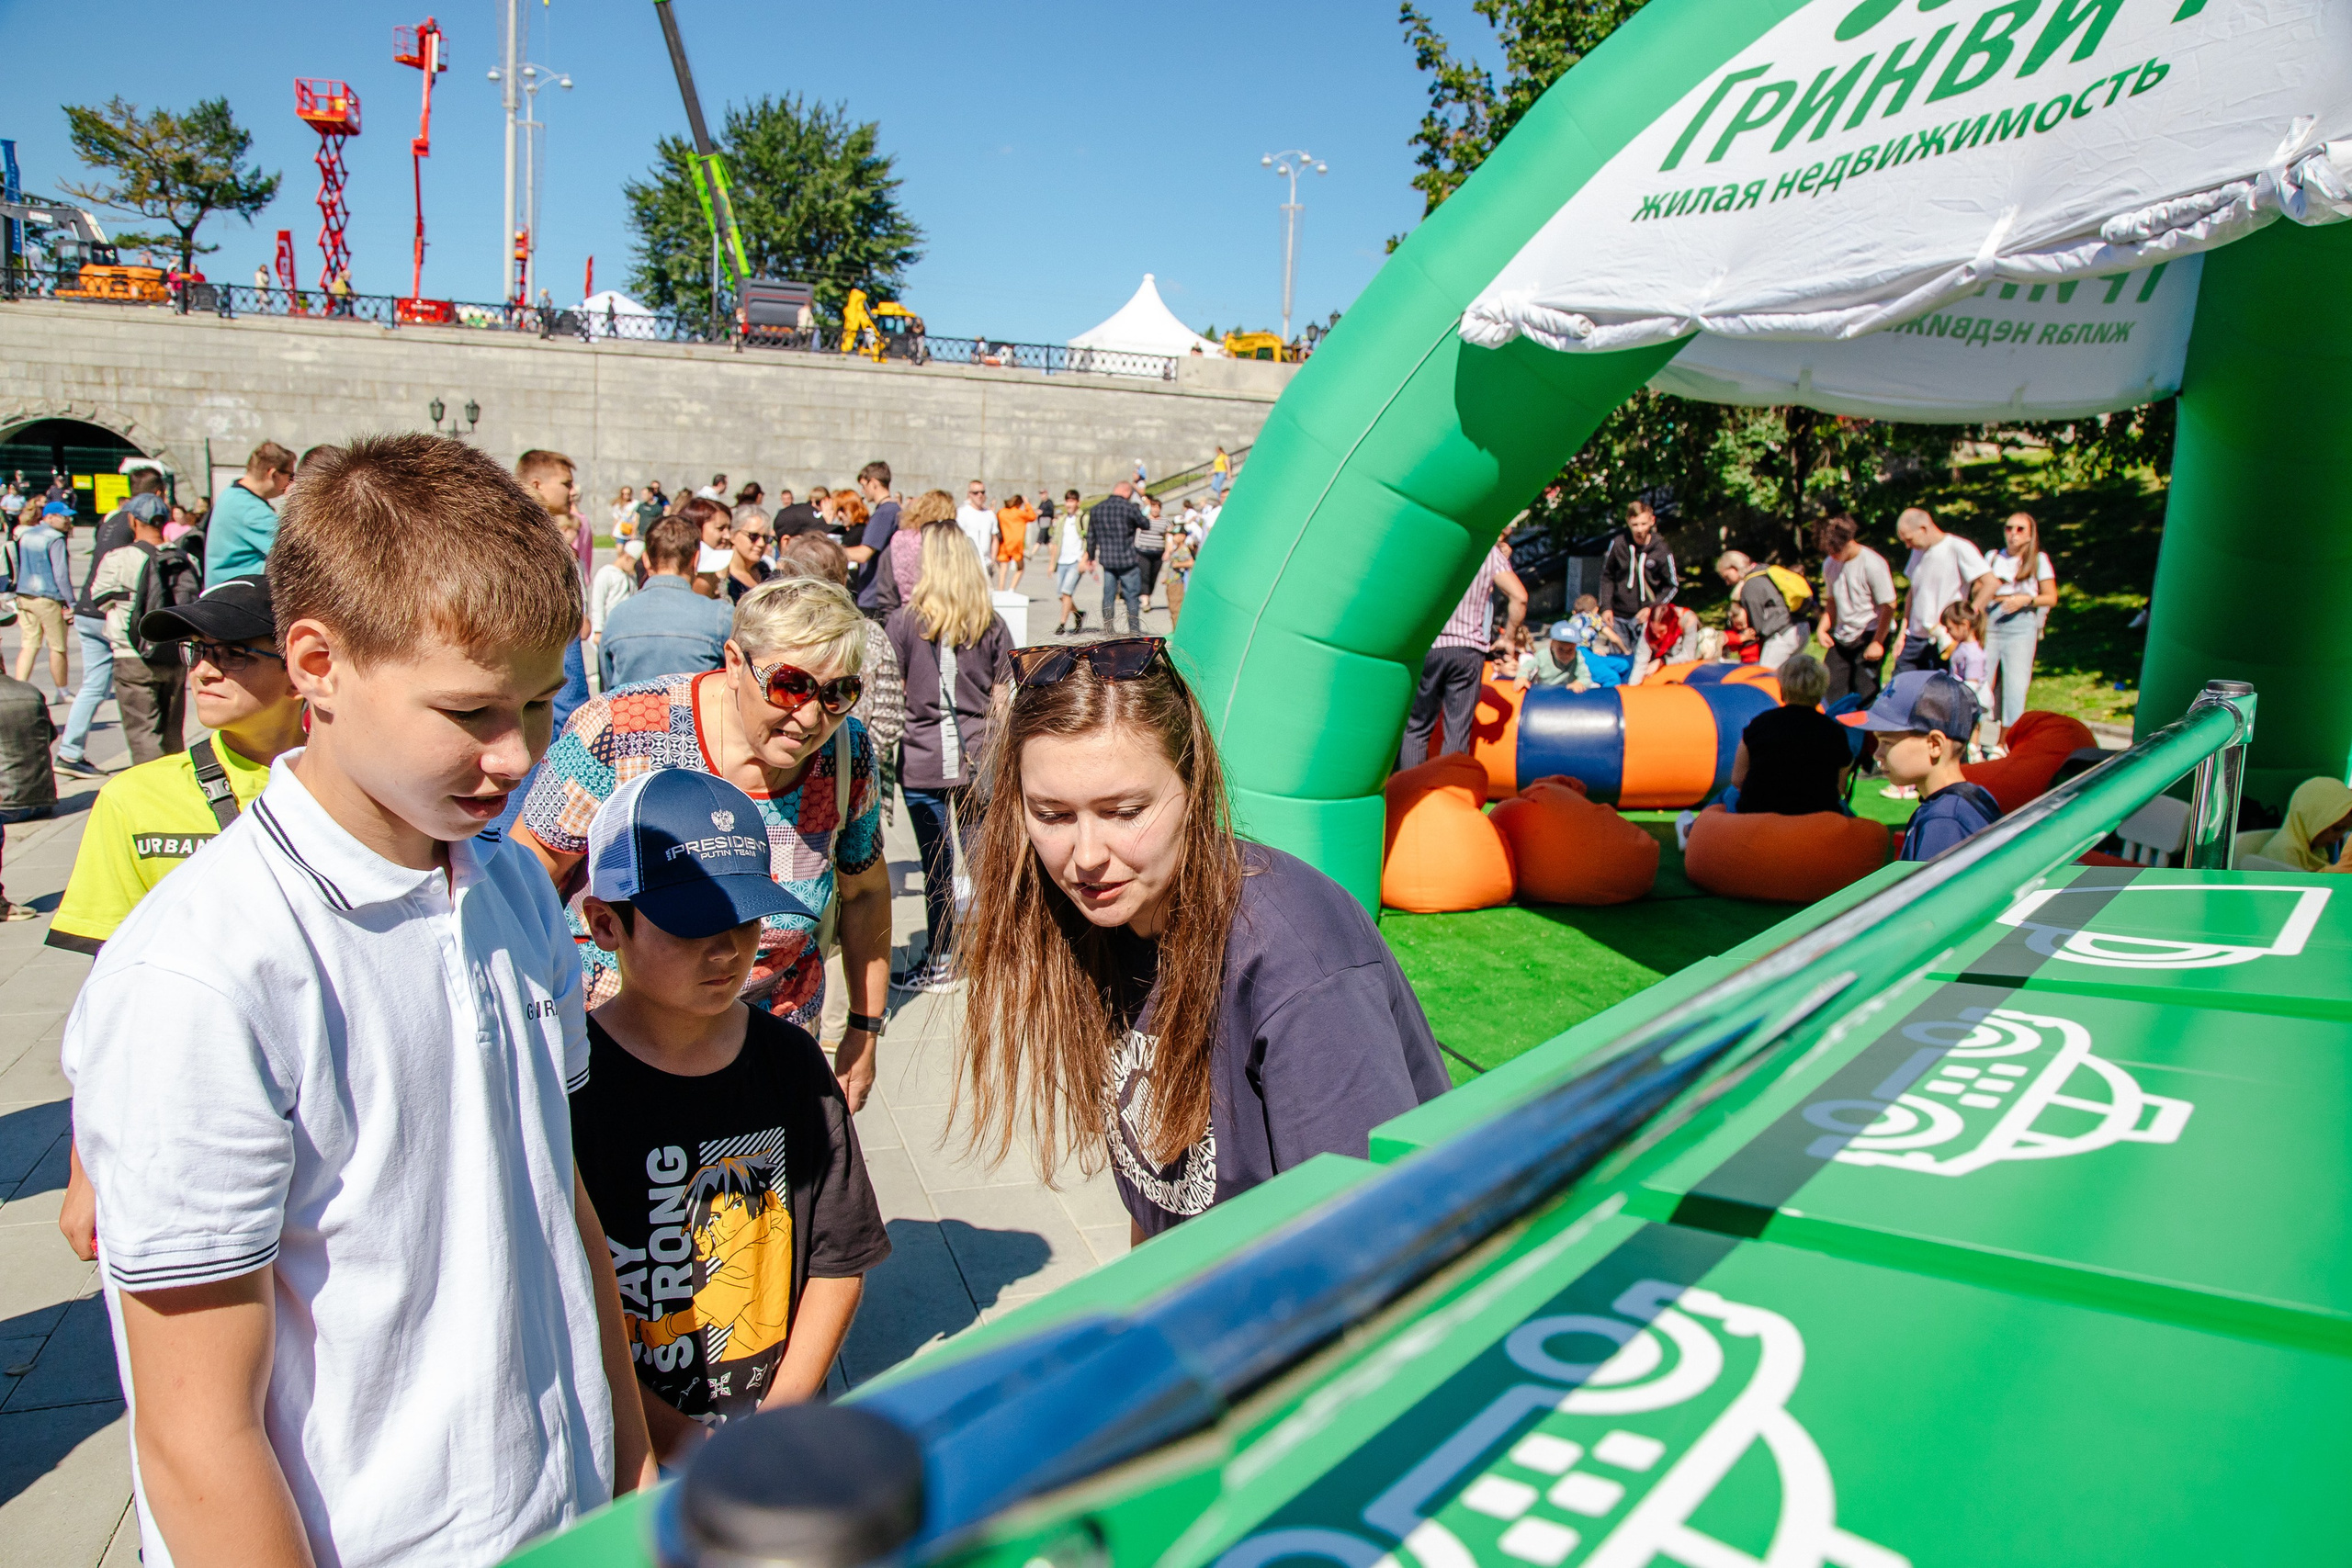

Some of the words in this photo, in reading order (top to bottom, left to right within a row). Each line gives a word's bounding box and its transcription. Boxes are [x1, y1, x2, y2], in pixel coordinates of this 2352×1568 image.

[1658, 0, 2208, 173] ГРИНВИ
[1631, 178, 1767, 222] жилая
[1770, 56, 2172, 201] недвижимость
[671, 834, 766, 860] PRESIDENT
[699, 848, 731, 861] PUTIN
[733, 848, 756, 858] TEAM
